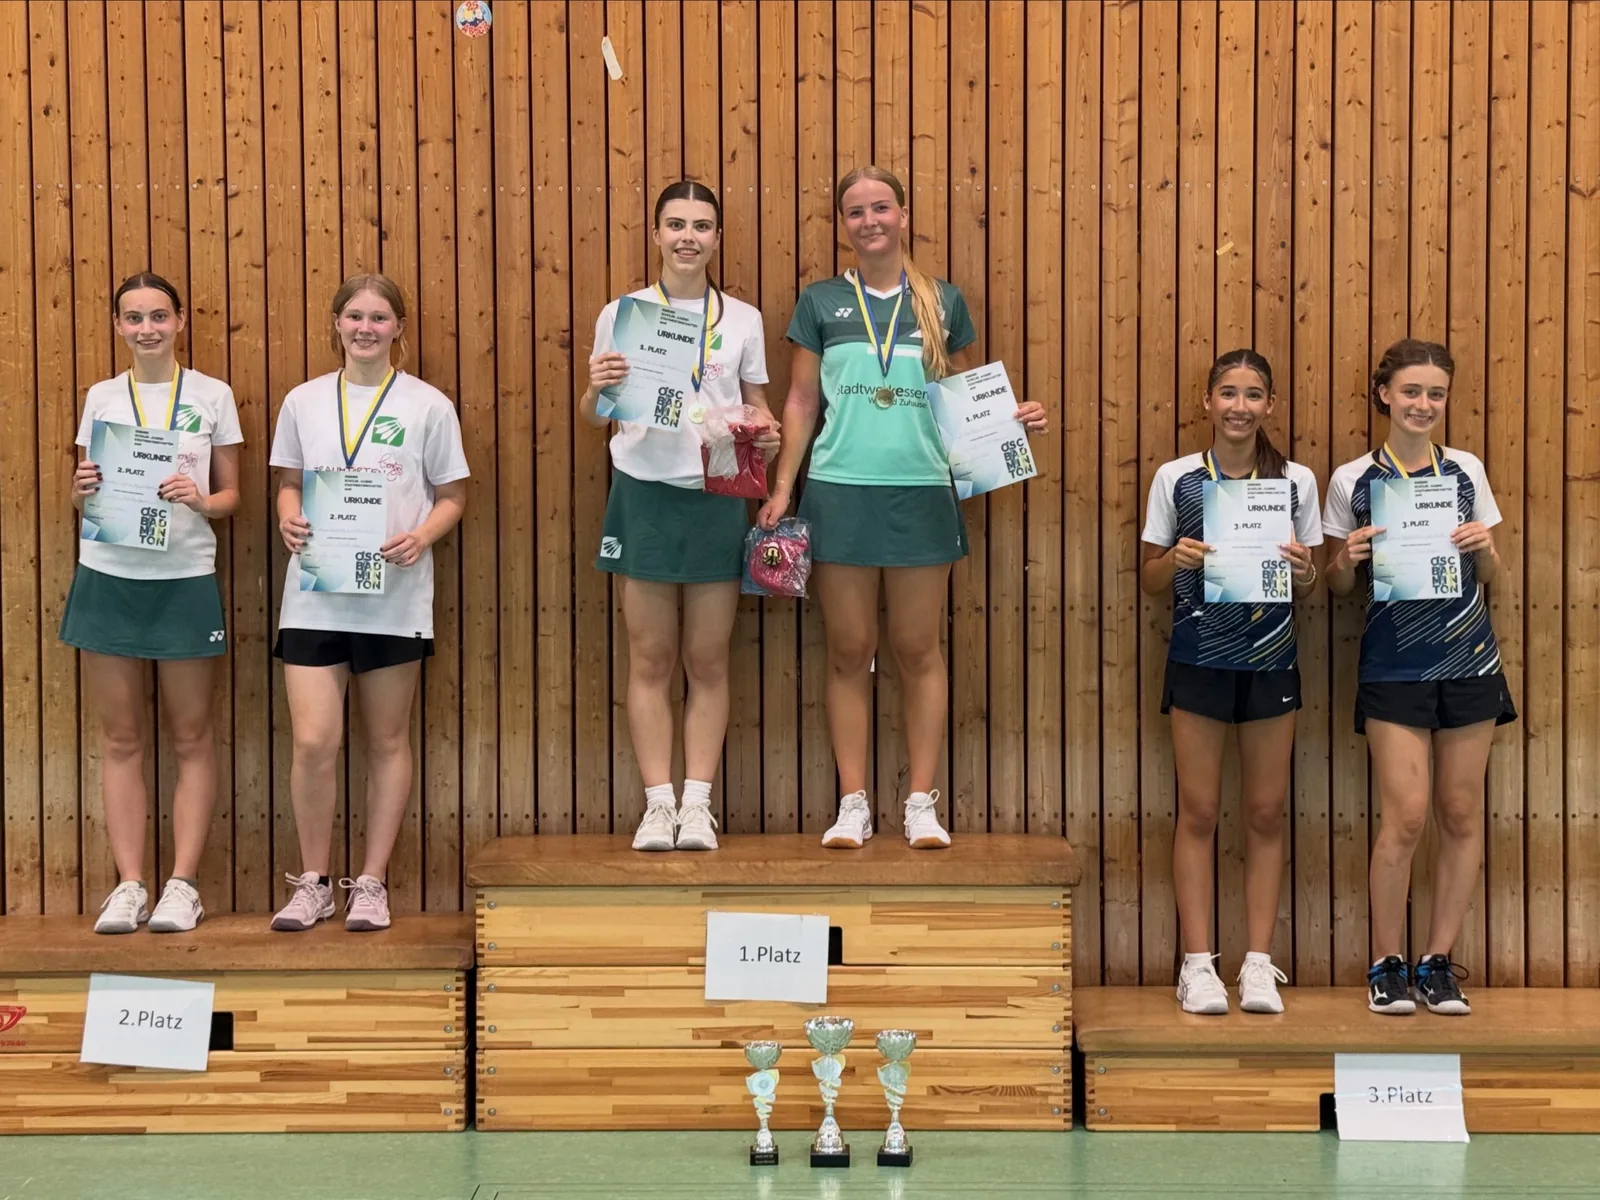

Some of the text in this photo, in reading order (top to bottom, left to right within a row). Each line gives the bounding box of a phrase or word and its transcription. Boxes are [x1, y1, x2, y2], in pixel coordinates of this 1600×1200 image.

[657, 329, 695, 345] URKUNDE
[647, 346, 667, 355] PLATZ
[972, 385, 1008, 402] URKUNDE
[899, 399, 928, 408] Zuhause
[972, 410, 991, 421] PLATZ
[654, 416, 679, 428] TON
[132, 451, 173, 463] URKUNDE
[125, 468, 145, 477] PLATZ
[1009, 466, 1034, 479] TON
[343, 496, 382, 505] URKUNDE
[1415, 501, 1453, 510] URKUNDE
[1247, 504, 1287, 512] URKUNDE
[1234, 523, 1242, 531] 3.
[1402, 521, 1410, 529] 3.
[139, 535, 165, 547] TON
[355, 580, 382, 590] TON
[1432, 584, 1459, 595] TON
[1262, 588, 1288, 598] TON
[739, 946, 801, 963] 1.Platz
[119, 1008, 183, 1030] 2.Platz
[1368, 1085, 1433, 1104] 3.Platz
